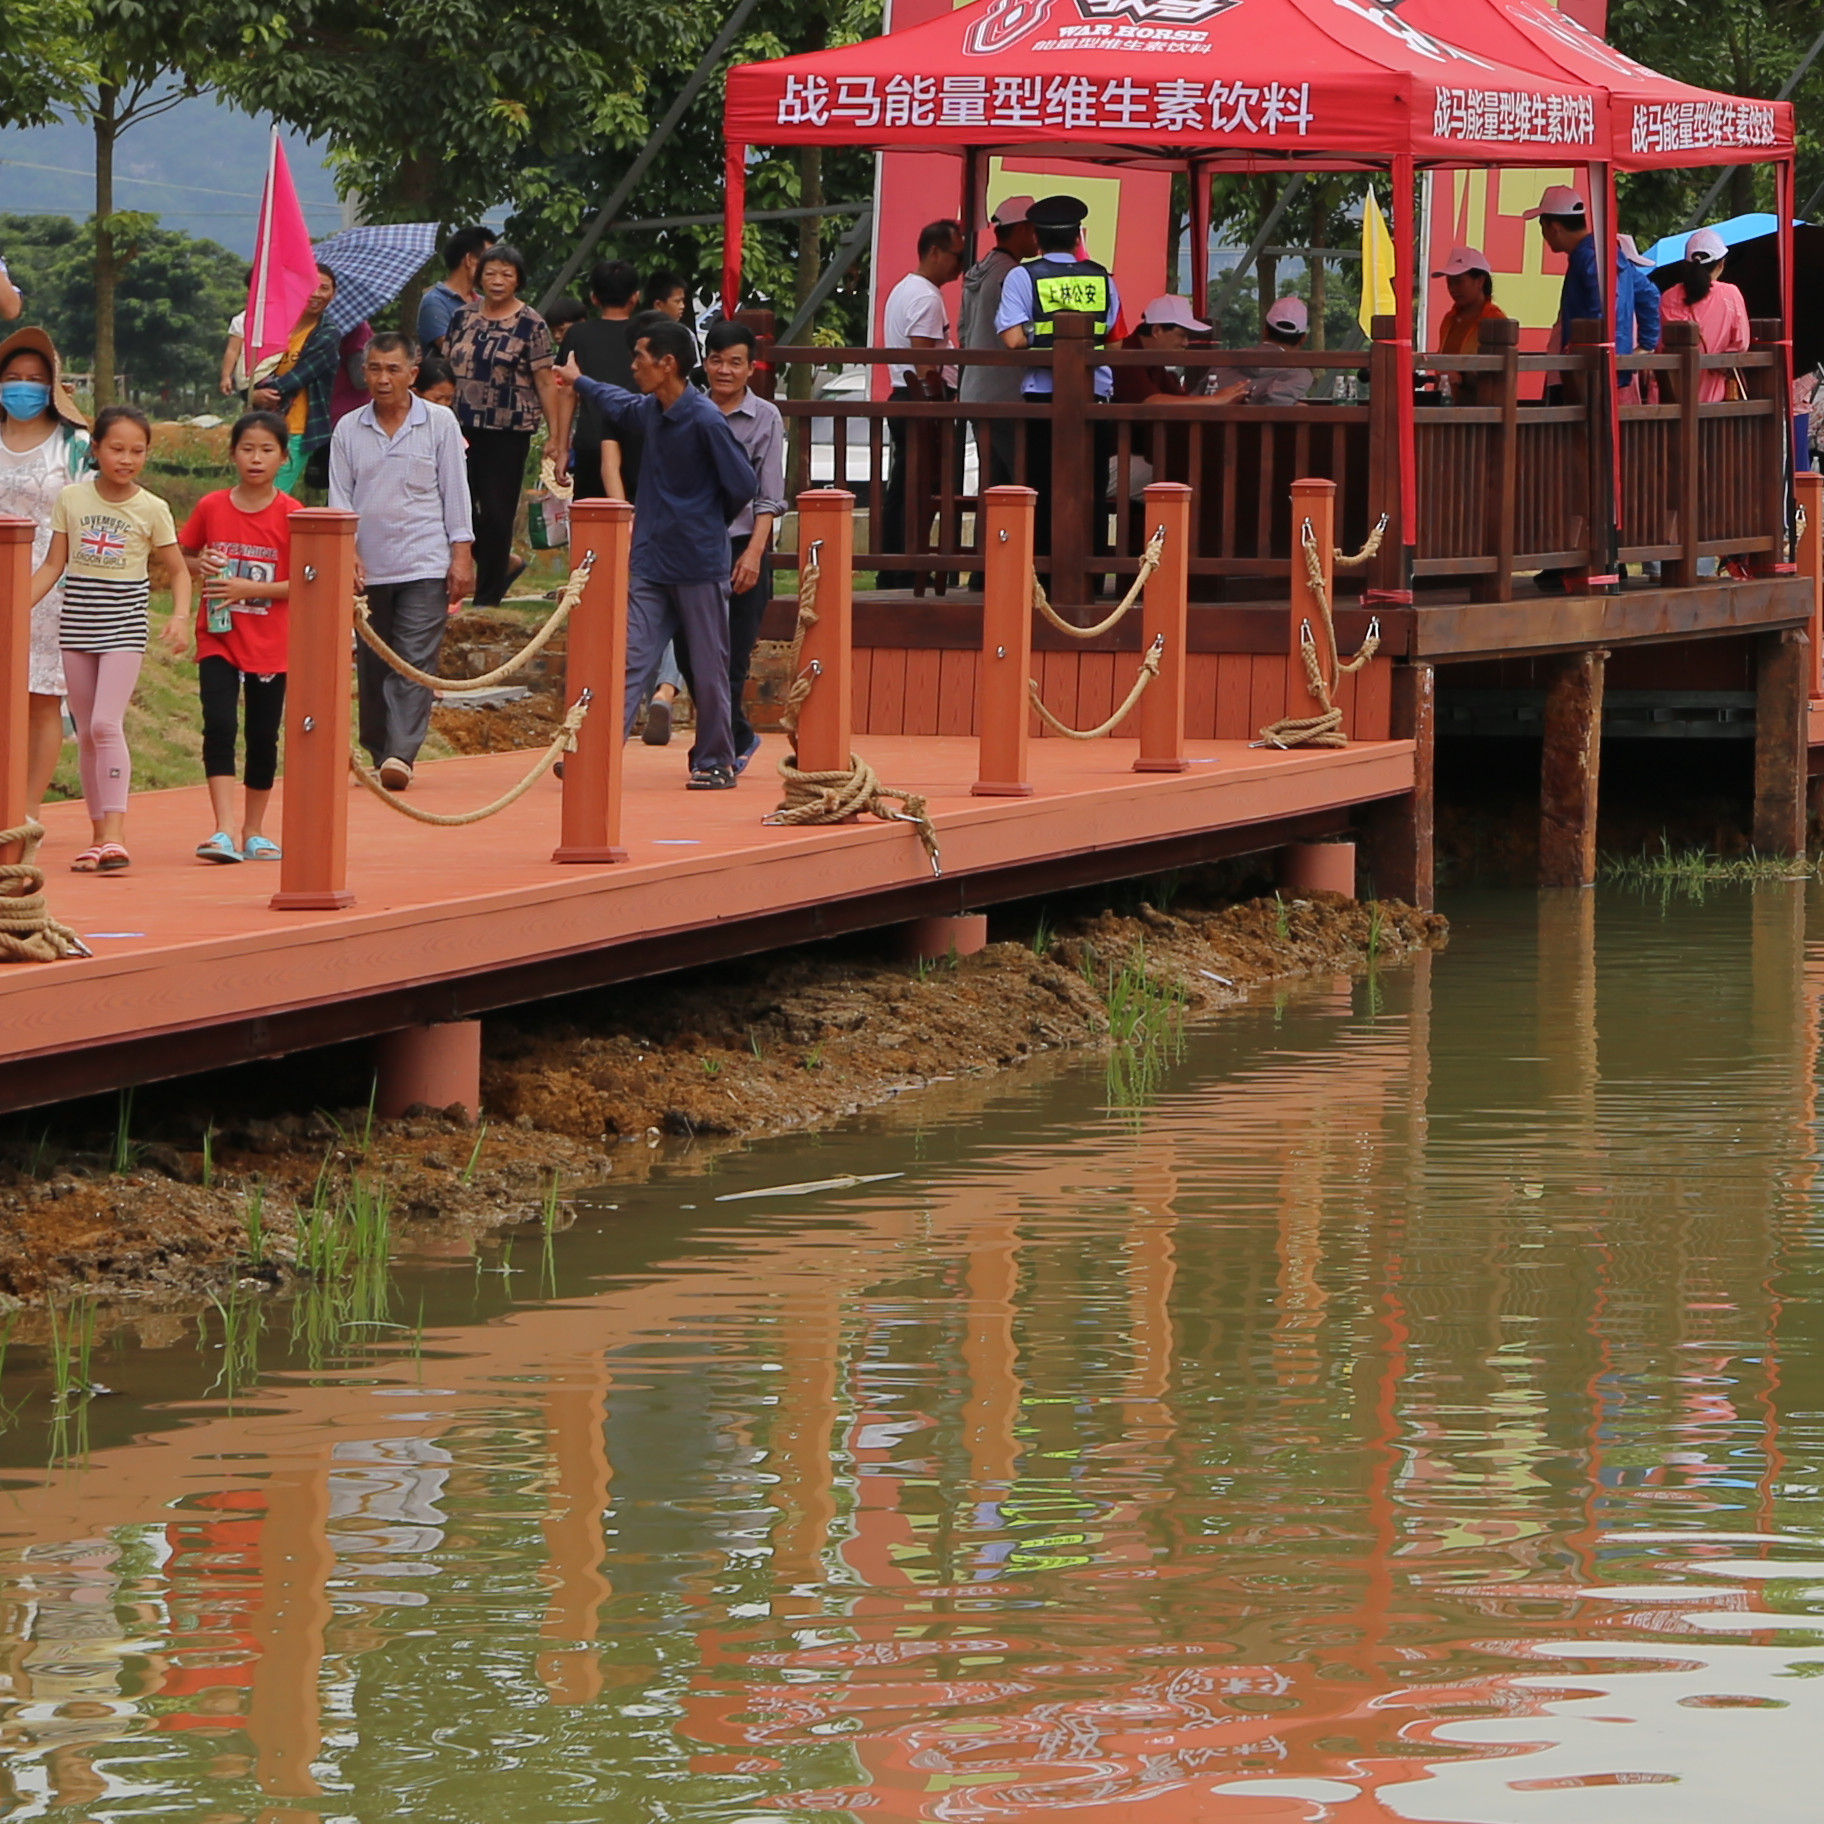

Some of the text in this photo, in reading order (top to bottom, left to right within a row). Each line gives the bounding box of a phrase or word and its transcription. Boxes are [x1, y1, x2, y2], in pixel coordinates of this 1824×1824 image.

[1058, 23, 1210, 43] WAR HORSE
[1031, 36, 1214, 56] 能量型维生素饮料
[777, 75, 1314, 137] 战马能量型维生素饮料
[1433, 85, 1595, 146] 战马能量型维生素饮料
[1048, 282, 1097, 305] 上林公安
